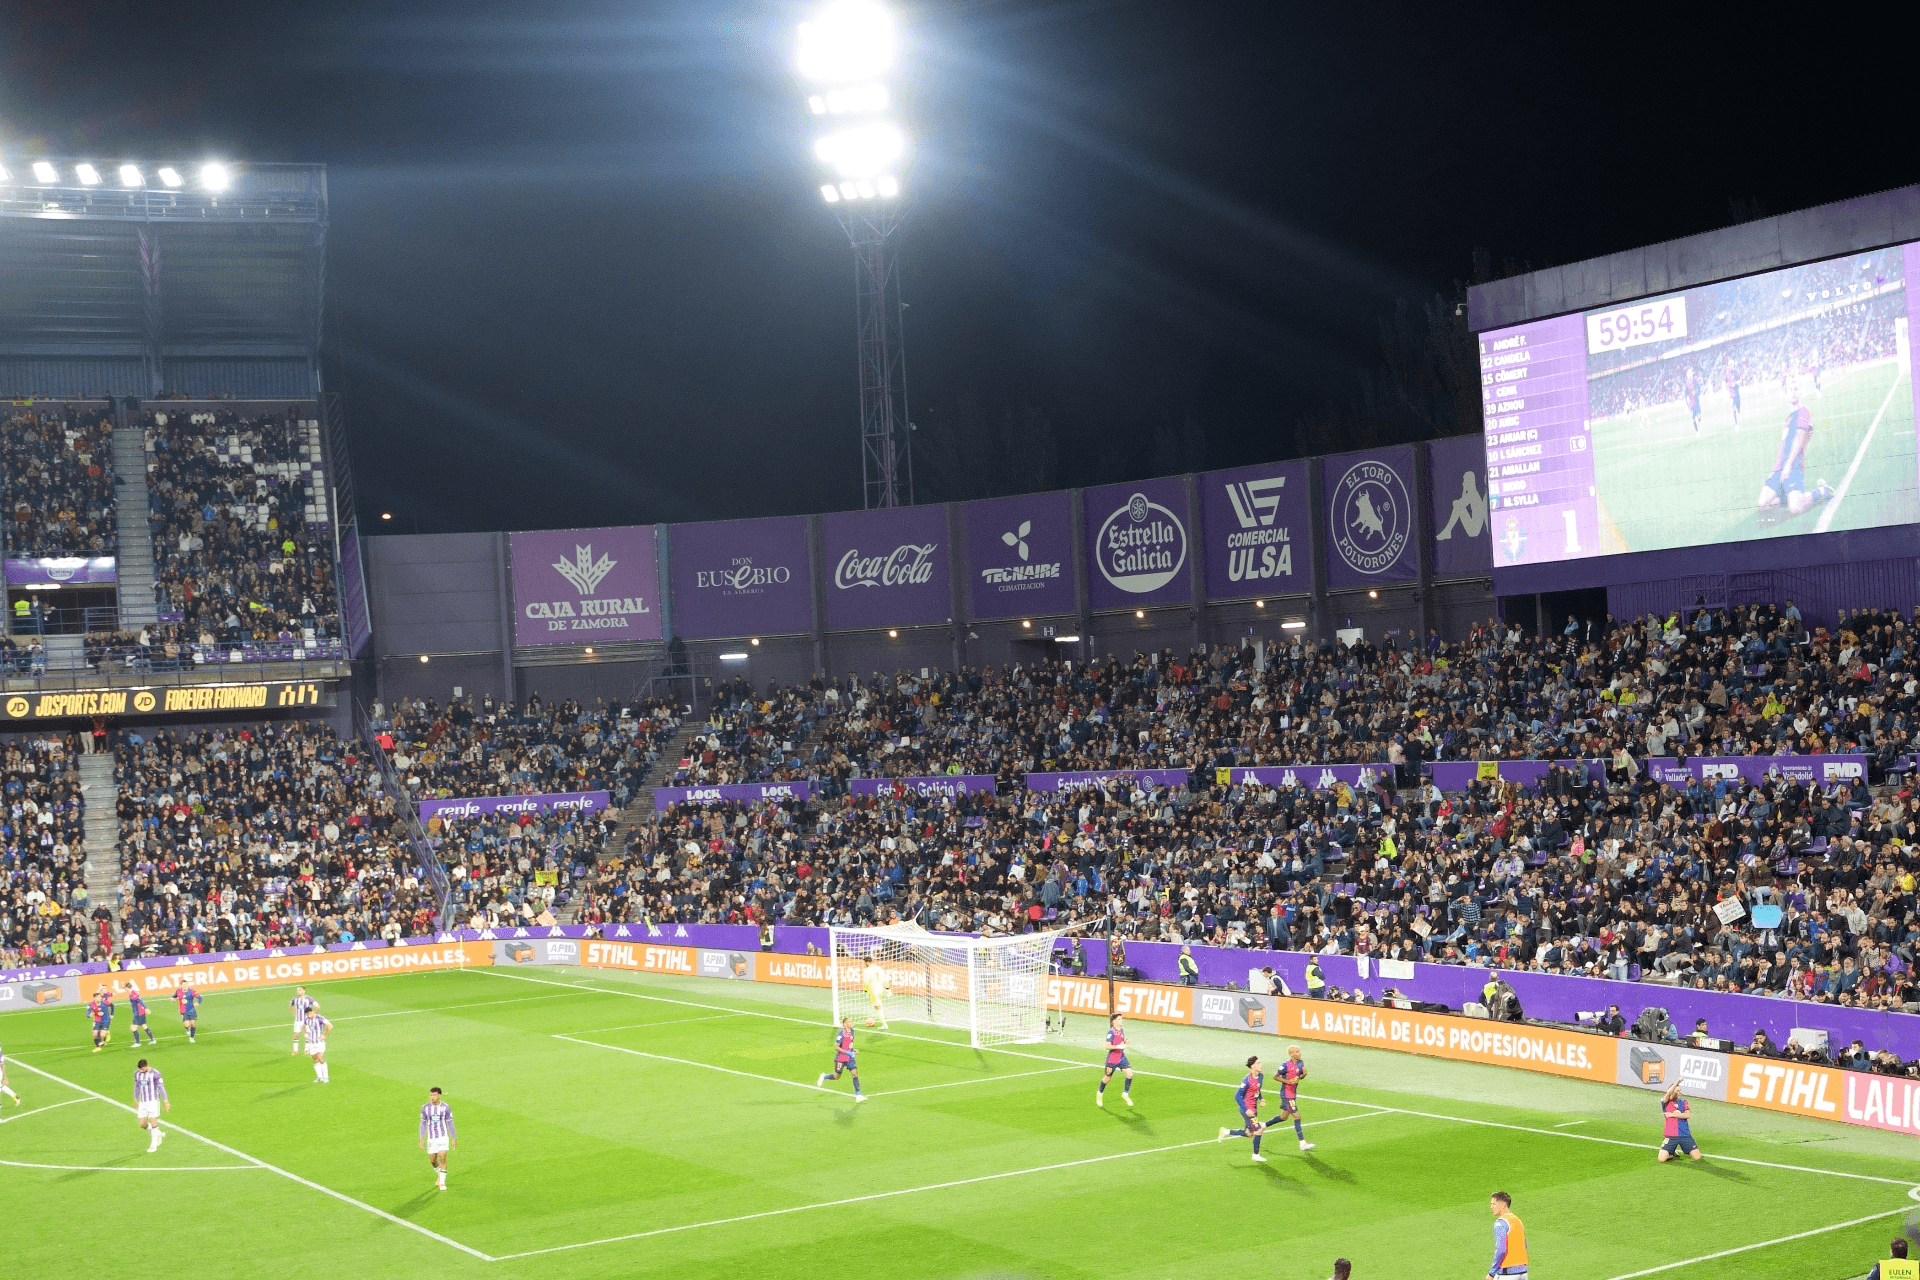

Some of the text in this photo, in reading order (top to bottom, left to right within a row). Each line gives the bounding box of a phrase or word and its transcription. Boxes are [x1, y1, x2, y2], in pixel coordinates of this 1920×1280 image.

[1806, 282, 1872, 301] VOLVO
[1600, 305, 1674, 346] 59:54
[1482, 351, 1530, 369] 22 CANDELA
[1483, 374, 1494, 385] 15
[1484, 390, 1490, 399] 6
[1485, 404, 1496, 415] 39
[1486, 419, 1497, 430] 20
[1487, 435, 1498, 446] 23
[1488, 451, 1498, 462] 10
[1346, 466, 1392, 489] EL TORO
[1489, 461, 1540, 478] 21 AMALLAH
[1514, 494, 1539, 506] SYLLA
[1108, 521, 1174, 549] Estrella
[1228, 527, 1290, 548] COMERCIAL
[1562, 510, 1581, 553] 1
[1112, 546, 1172, 573] Galicia
[1340, 532, 1403, 568] POLVORONES
[732, 557, 752, 566] DON
[834, 544, 938, 589] Coca-Cola
[1228, 544, 1292, 582] ULSA
[982, 562, 1060, 583] TECNAIRE
[526, 598, 649, 619] CAJA RURAL
[548, 618, 629, 631] DE ZAMORA
[10, 686, 267, 716] JD JDSPORTS.COM JD FOREVER FORWARD
[686, 789, 722, 800] LOCK
[762, 786, 793, 797] LOCK
[438, 802, 480, 818] renfe
[496, 799, 537, 813] renfe
[554, 796, 593, 810] renfe
[588, 944, 692, 972] STIHL STIHL
[113, 949, 470, 993] LA BATERÍA DE LOS PROFESIONALES.
[769, 962, 782, 976] LA
[783, 960, 823, 980] BATERÍA
[1047, 980, 1107, 1010] STIHL
[1116, 986, 1184, 1018] STIHL
[1301, 1010, 1592, 1069] LA BATERÍA DE LOS PROFESIONALES.
[1738, 1062, 1836, 1112] STIHL
